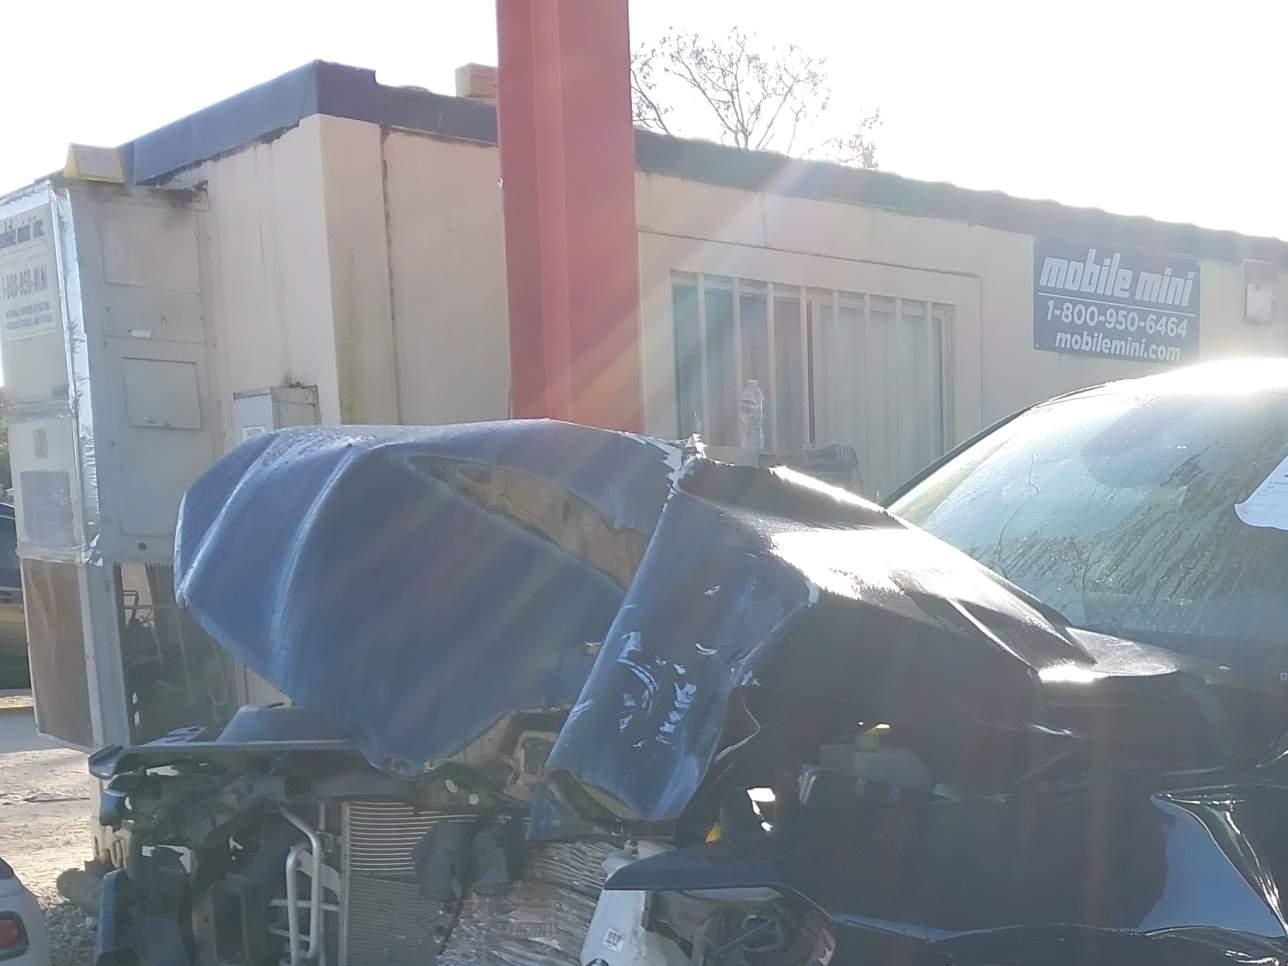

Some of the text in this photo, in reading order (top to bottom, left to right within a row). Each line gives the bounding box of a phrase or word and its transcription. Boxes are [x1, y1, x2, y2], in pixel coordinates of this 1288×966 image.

[1039, 248, 1194, 307] mobile mini
[1046, 300, 1188, 338] 1-800-950-6464
[1054, 330, 1182, 361] mobilemini.com
